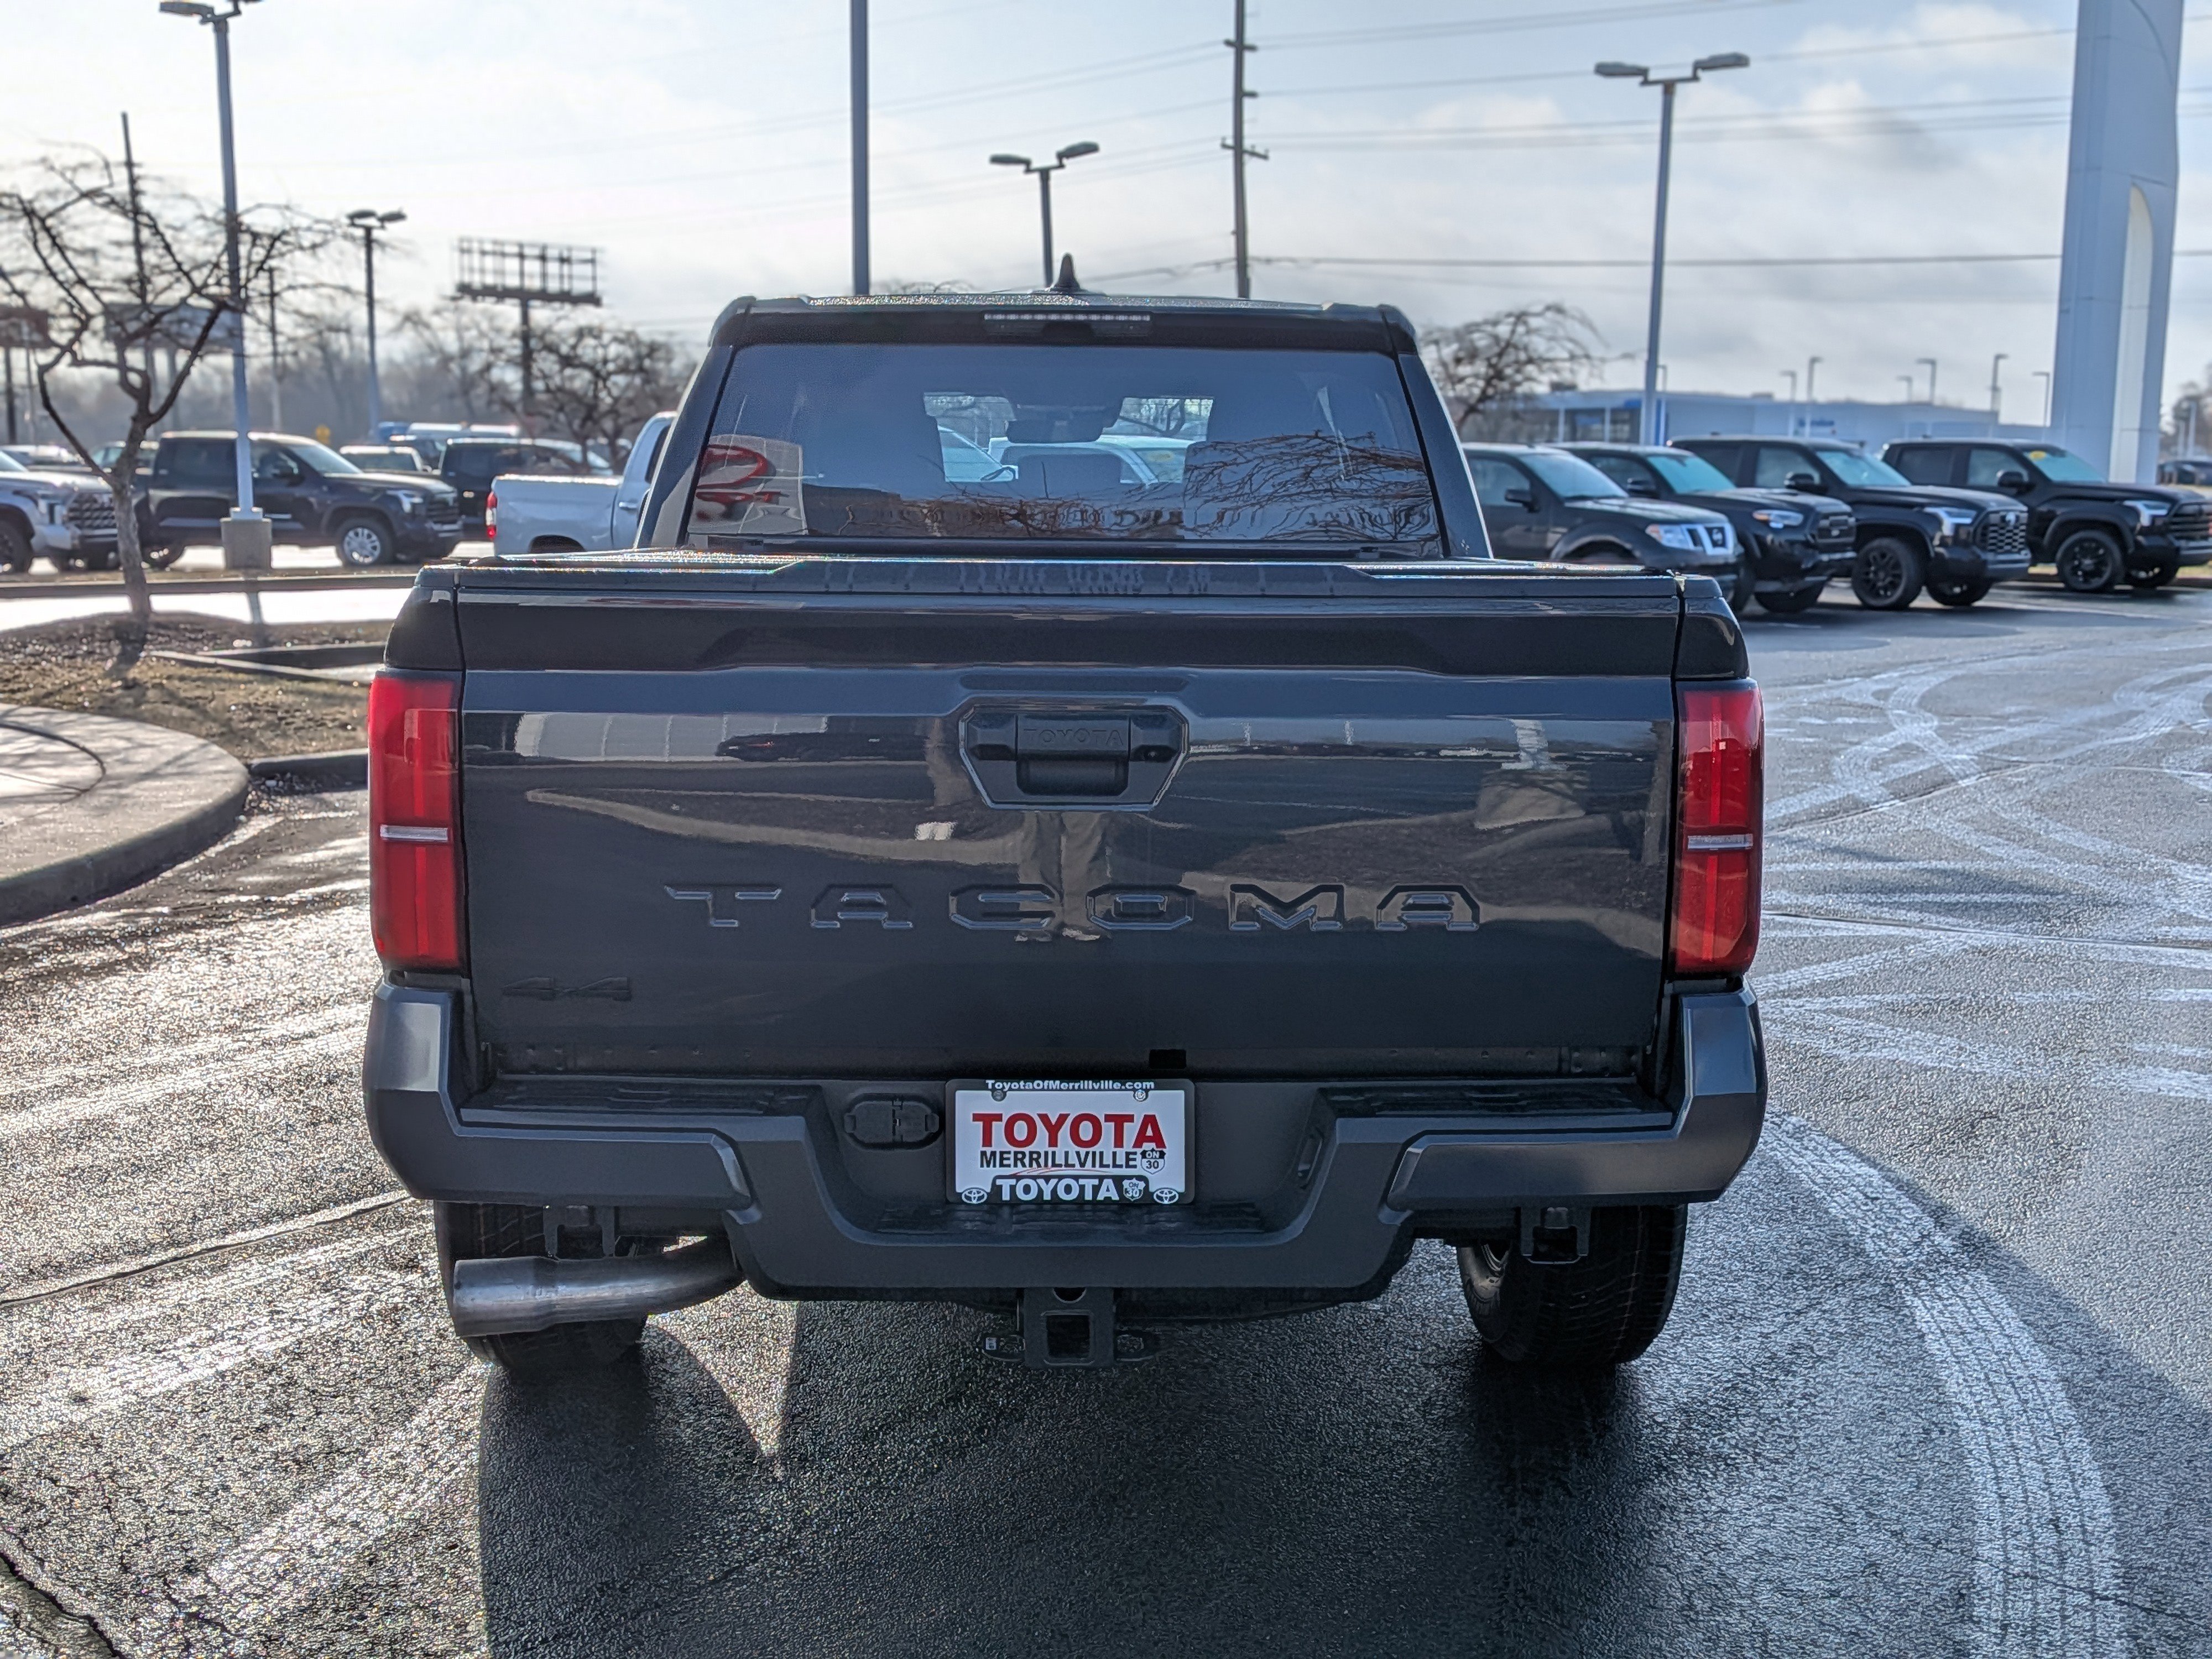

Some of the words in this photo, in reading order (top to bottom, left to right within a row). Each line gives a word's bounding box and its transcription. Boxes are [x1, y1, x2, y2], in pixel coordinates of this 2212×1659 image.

[1023, 728, 1124, 747] TOYOTA
[665, 884, 1480, 933] TACOMA
[986, 1079, 1155, 1091] ToyotaOfMerrillville.com
[972, 1113, 1167, 1148] TOYOTA
[980, 1151, 1137, 1168] MERRILLVILLE
[1146, 1160, 1159, 1169] 30
[996, 1178, 1119, 1201] TOYOTA
